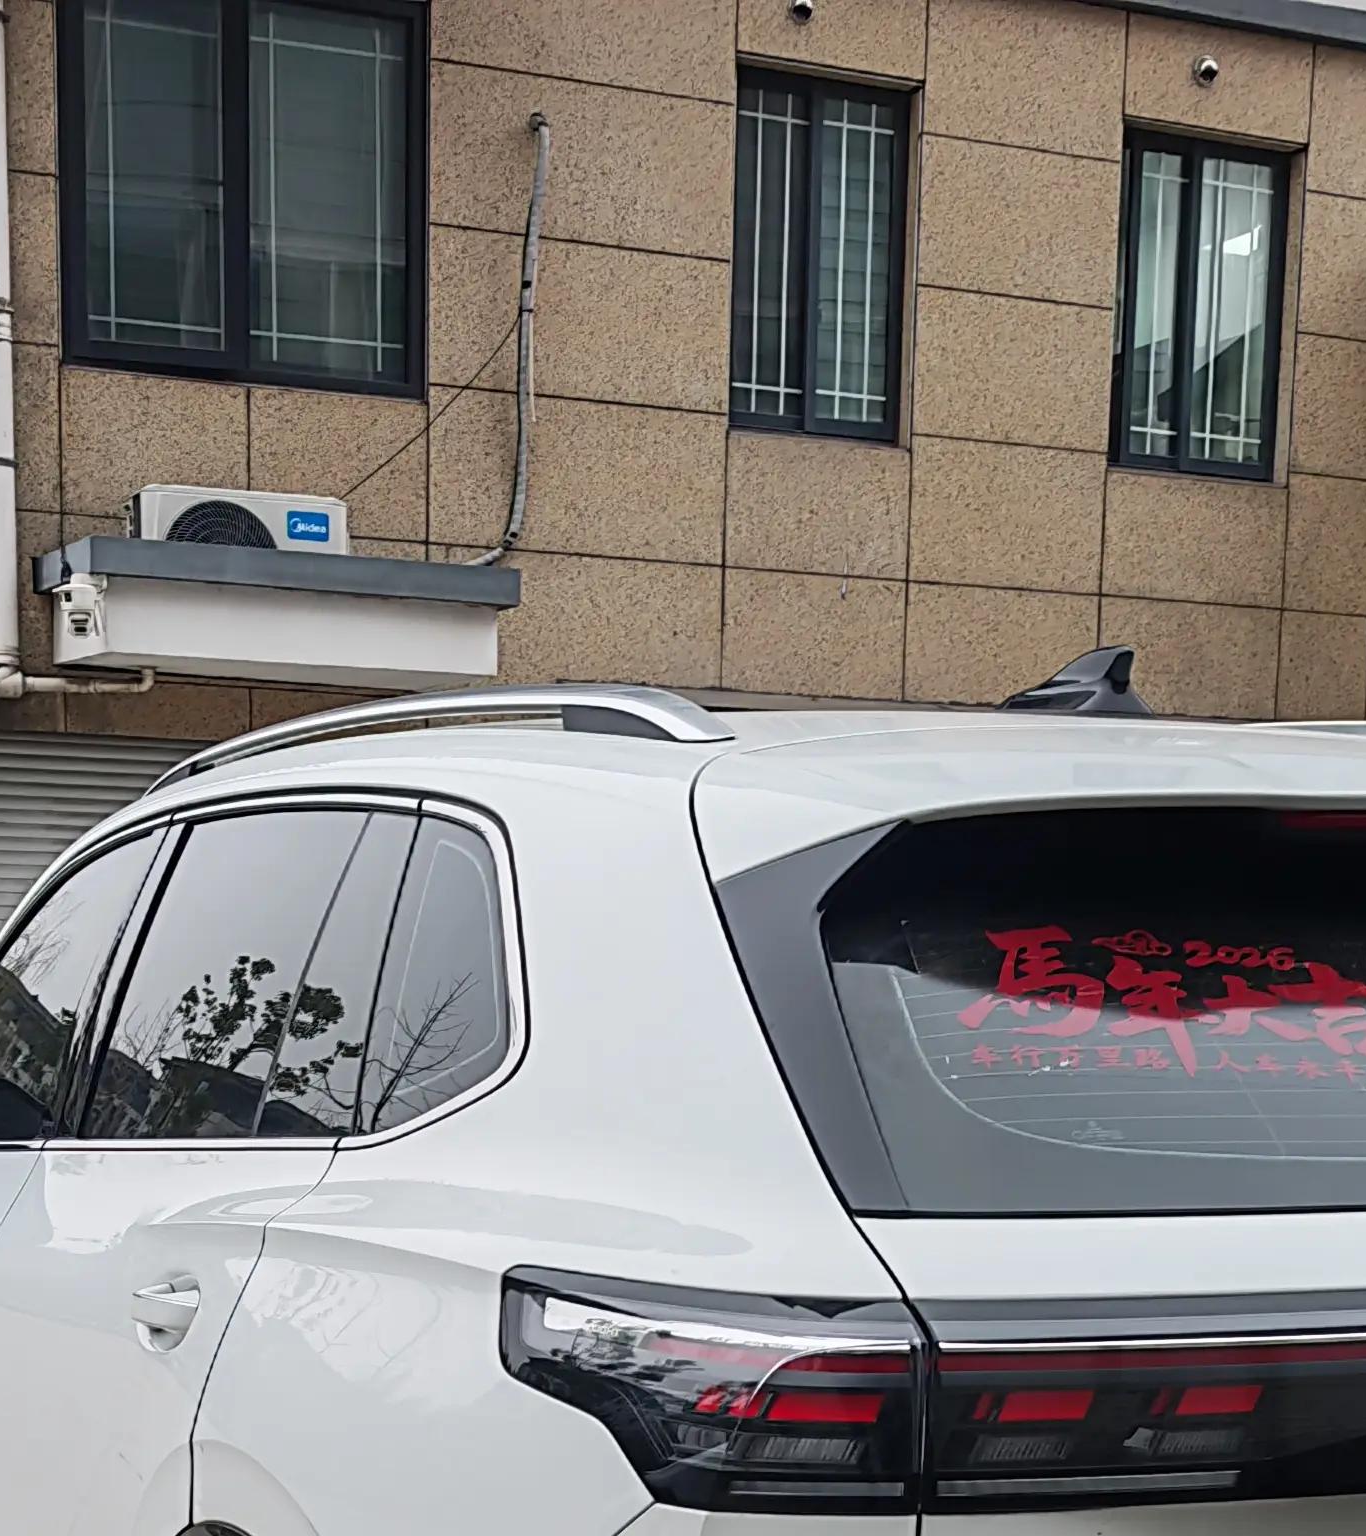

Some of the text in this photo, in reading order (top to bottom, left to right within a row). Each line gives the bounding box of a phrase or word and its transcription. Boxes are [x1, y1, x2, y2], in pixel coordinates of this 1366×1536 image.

[293, 519, 327, 534] Midea
[1183, 940, 1300, 971] 2026
[969, 1043, 1172, 1070] 车行万里路
